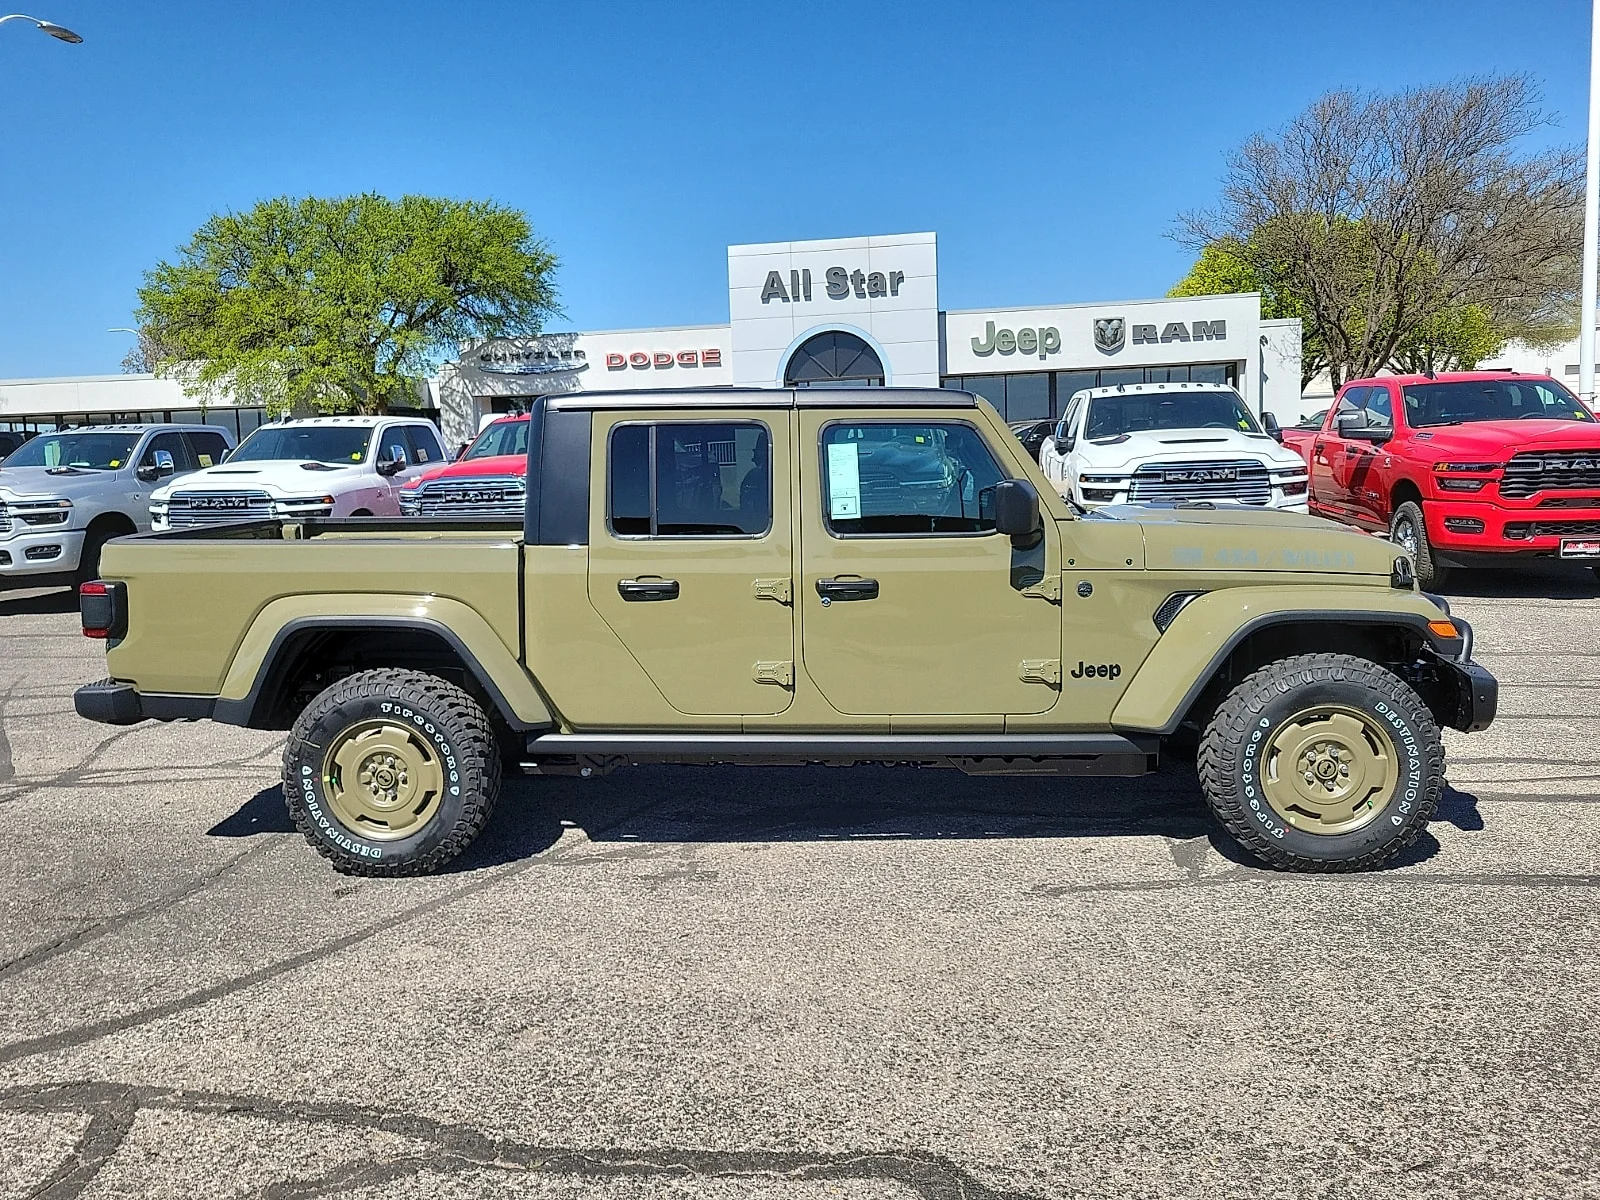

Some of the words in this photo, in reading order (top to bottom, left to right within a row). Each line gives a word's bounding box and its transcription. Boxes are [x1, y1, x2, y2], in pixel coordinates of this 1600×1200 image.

[761, 269, 812, 303] All
[826, 266, 904, 300] Star
[971, 321, 1061, 360] Jeep
[1132, 320, 1226, 344] RAM
[606, 349, 721, 370] DODGE
[1166, 469, 1235, 481] RAM
[1545, 459, 1600, 469] RA
[1070, 661, 1121, 680] Jeep
[1374, 701, 1420, 814] DESTINATION
[302, 778, 382, 859] DESTINATION
